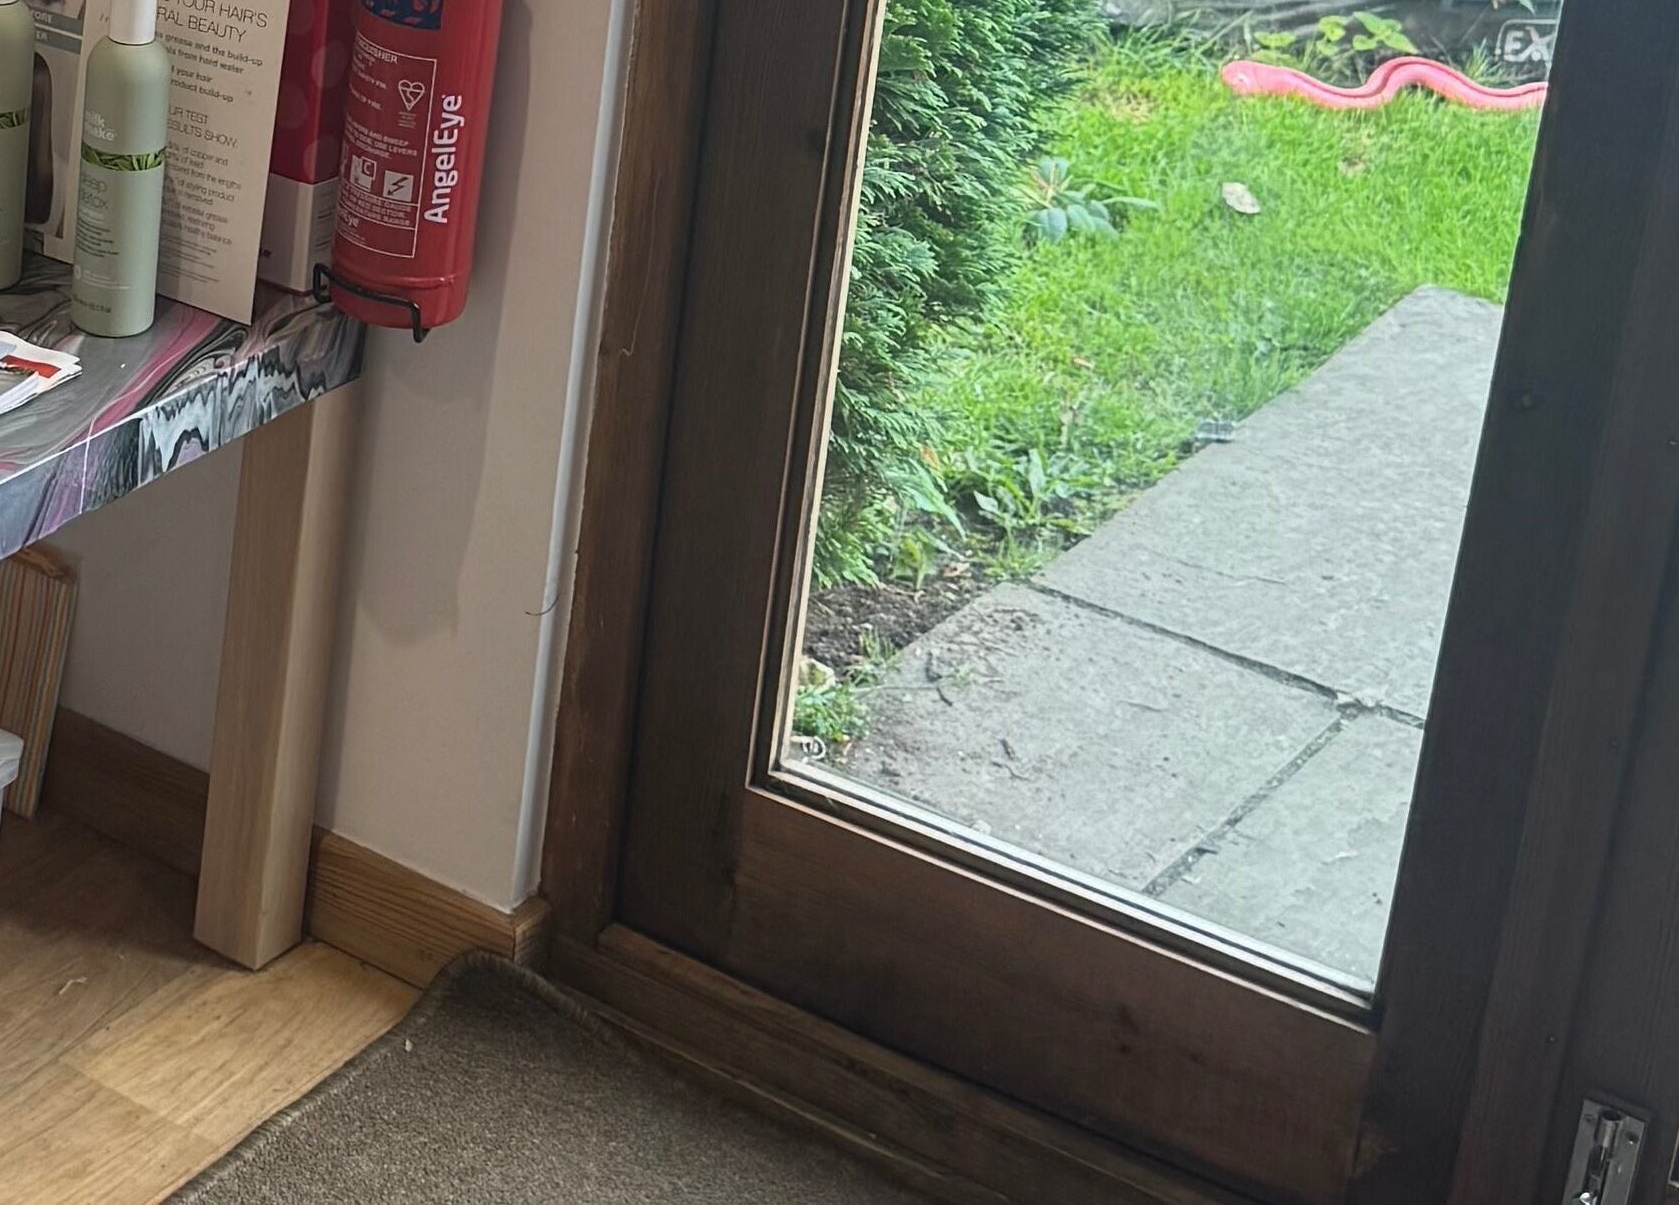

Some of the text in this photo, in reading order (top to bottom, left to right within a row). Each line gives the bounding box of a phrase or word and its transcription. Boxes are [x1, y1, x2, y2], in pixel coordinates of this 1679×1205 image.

[218, 2, 269, 29] HAIR'S
[187, 15, 247, 43] BEAUTY
[177, 49, 198, 62] from
[194, 39, 211, 53] and
[212, 45, 226, 57] the
[227, 49, 263, 67] build-up
[176, 67, 214, 84] your hair
[170, 78, 234, 104] roduct build-up
[167, 118, 203, 138] ESULTS
[185, 109, 208, 125] TEST
[423, 94, 466, 225] AngelEye
